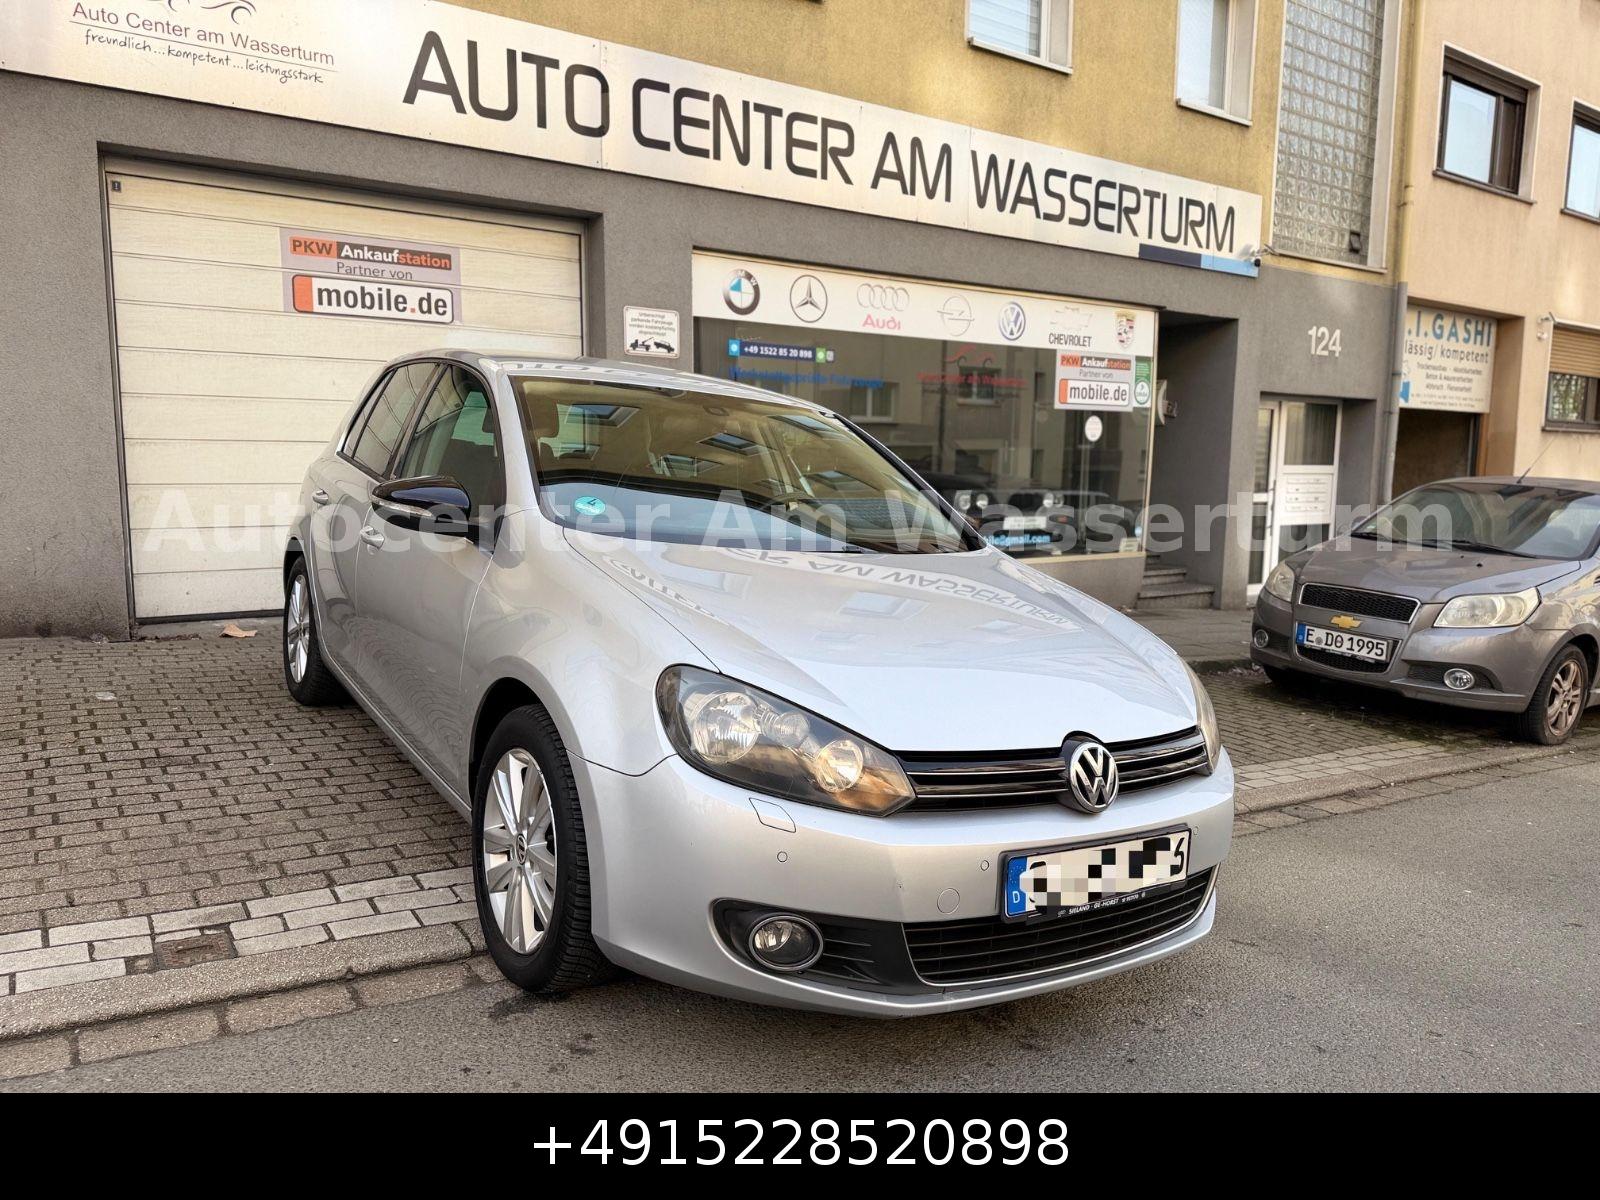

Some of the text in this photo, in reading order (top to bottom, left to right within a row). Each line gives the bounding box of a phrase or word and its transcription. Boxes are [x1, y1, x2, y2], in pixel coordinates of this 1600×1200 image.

[71, 2, 335, 66] Auto Center am Wasserturm
[402, 30, 1236, 254] AUTO CENTER AM WASSERTURM
[292, 239, 451, 269] PKW Ankaufstation
[336, 261, 413, 281] Partner von
[316, 285, 448, 317] mobile.de
[862, 313, 903, 330] Audi
[1048, 332, 1093, 348] CHEVROLET
[1307, 325, 1342, 358] 124
[744, 345, 759, 354] +49
[760, 346, 778, 356] 1522
[788, 348, 799, 358] 20
[1060, 355, 1081, 367] PKW
[1440, 344, 1489, 364] kompetent
[1079, 369, 1101, 378] Partner
[1069, 384, 1128, 402] mobile.de
[1305, 627, 1316, 644] E
[1346, 636, 1386, 658] 1995
[1012, 890, 1022, 904] D
